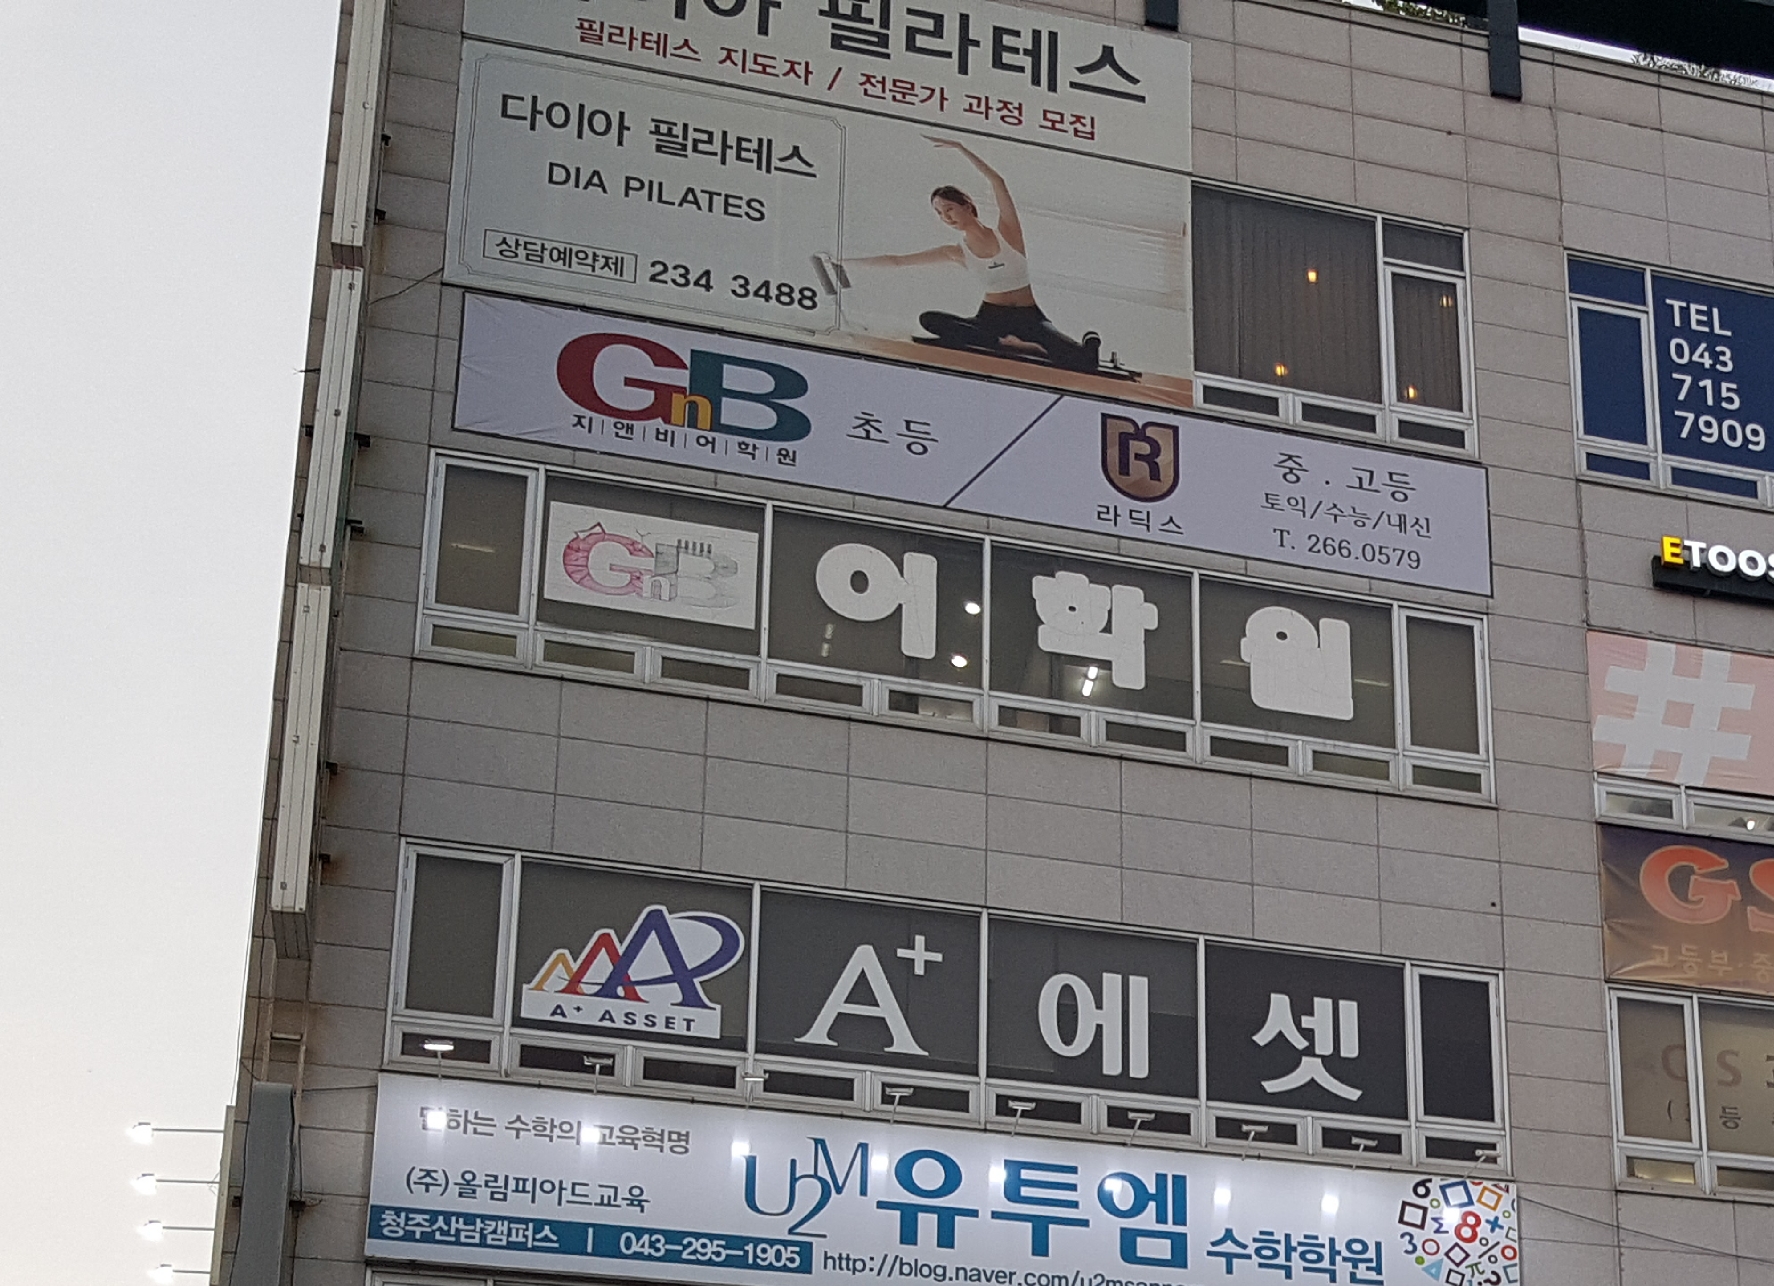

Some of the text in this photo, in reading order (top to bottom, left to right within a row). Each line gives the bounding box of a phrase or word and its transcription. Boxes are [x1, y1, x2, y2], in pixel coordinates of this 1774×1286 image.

[575, 17, 701, 62] 필라테스
[718, 44, 813, 86] 지도자
[858, 72, 949, 112] 전문가
[962, 91, 1024, 128] 과정
[1038, 108, 1097, 140] 모집
[500, 93, 818, 178] 다이아 필라테스
[547, 160, 767, 223] DIA PILATES
[496, 236, 820, 312] 상담예약제 234 3488
[1664, 298, 1733, 338] TEL
[1668, 336, 1734, 374] 043
[556, 332, 812, 442] GnB
[1671, 372, 1742, 413] 715
[846, 410, 940, 456] 초등
[1673, 409, 1767, 453] 7909
[1095, 503, 1185, 536] 라딕스
[1259, 490, 1433, 540] 토익/수능/내신
[1272, 527, 1423, 571] T. 266.0579
[793, 934, 944, 1057] A+
[596, 1008, 697, 1034] ASSET
[504, 1114, 582, 1146] 수학의
[406, 1165, 651, 1214] (주)올림피아드교육
[875, 1150, 1190, 1271] 유투엠
[379, 1211, 801, 1269] 청주산남캠퍼스 043-295-1905
